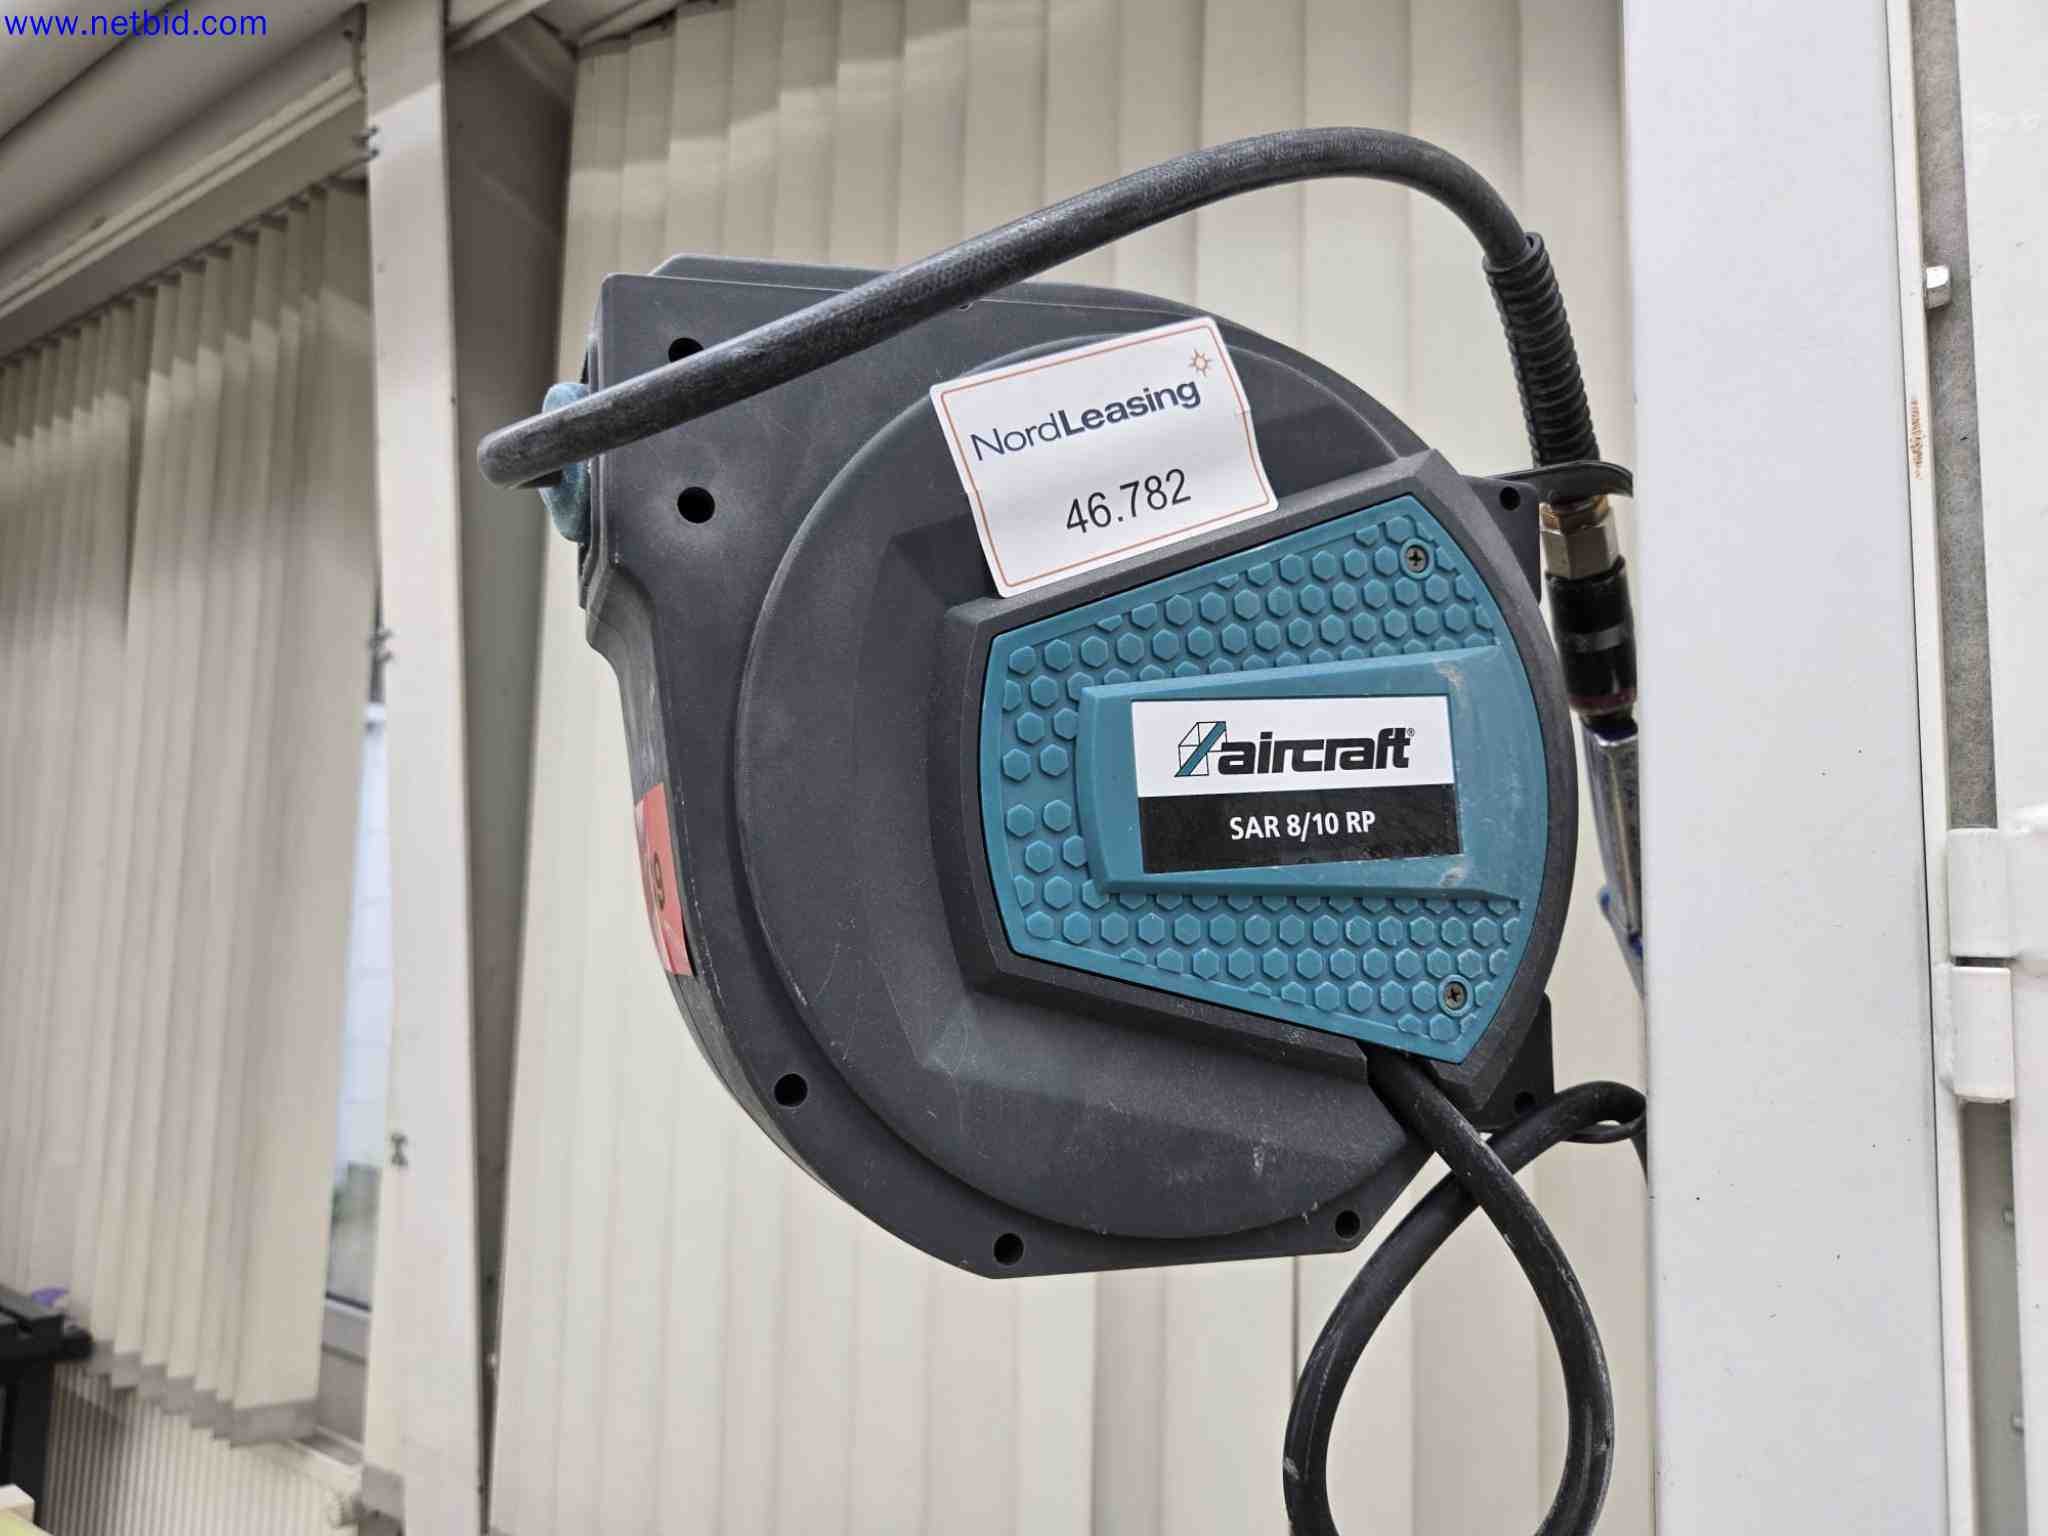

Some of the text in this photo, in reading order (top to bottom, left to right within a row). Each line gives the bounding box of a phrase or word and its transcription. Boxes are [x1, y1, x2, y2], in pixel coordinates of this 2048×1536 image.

[970, 381, 1201, 461] NordLeasing
[1066, 468, 1192, 534] 46.782
[1229, 810, 1376, 843] SAR 8/10 RP
